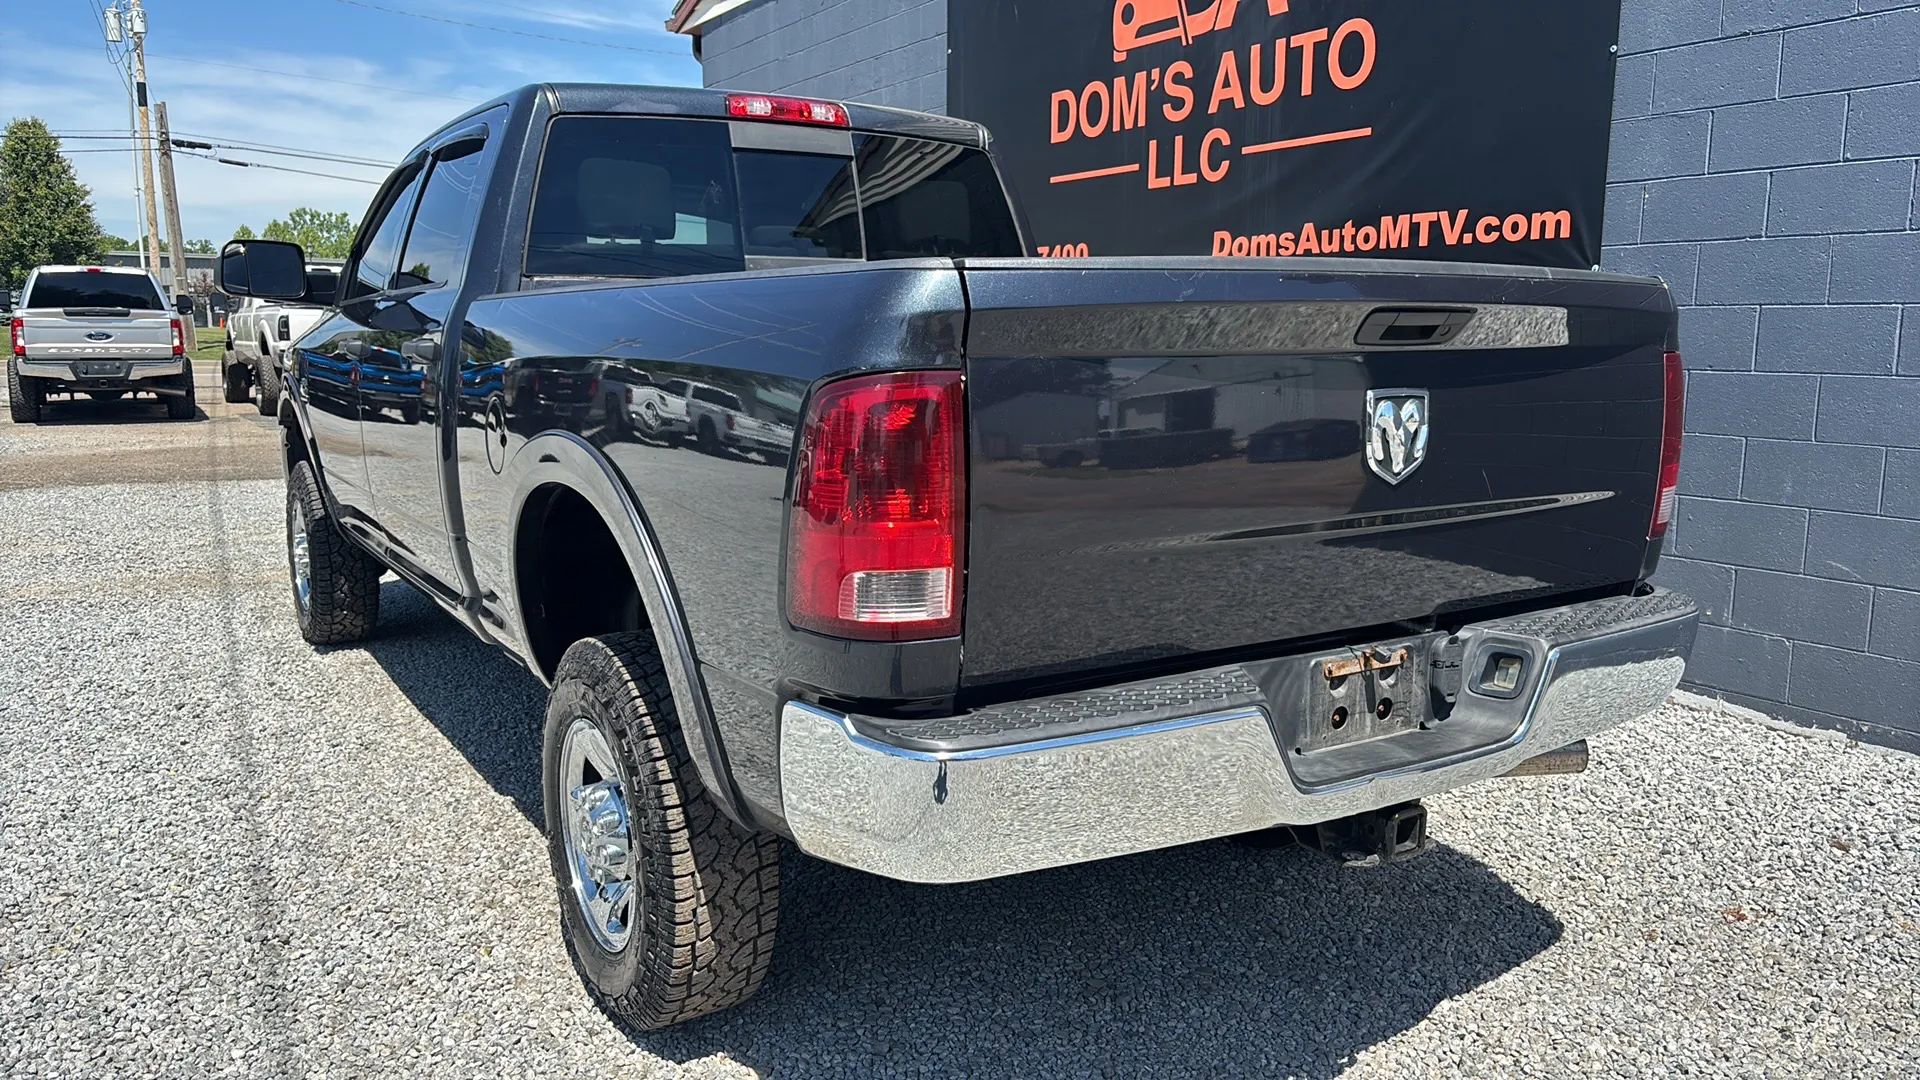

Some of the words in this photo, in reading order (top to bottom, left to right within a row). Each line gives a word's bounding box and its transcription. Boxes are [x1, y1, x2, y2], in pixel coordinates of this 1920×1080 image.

[1051, 60, 1194, 144] DOM'S
[1208, 18, 1376, 114] AUTO
[1147, 127, 1231, 190] LLC
[1212, 209, 1571, 257] DomsAutoMTV.com
